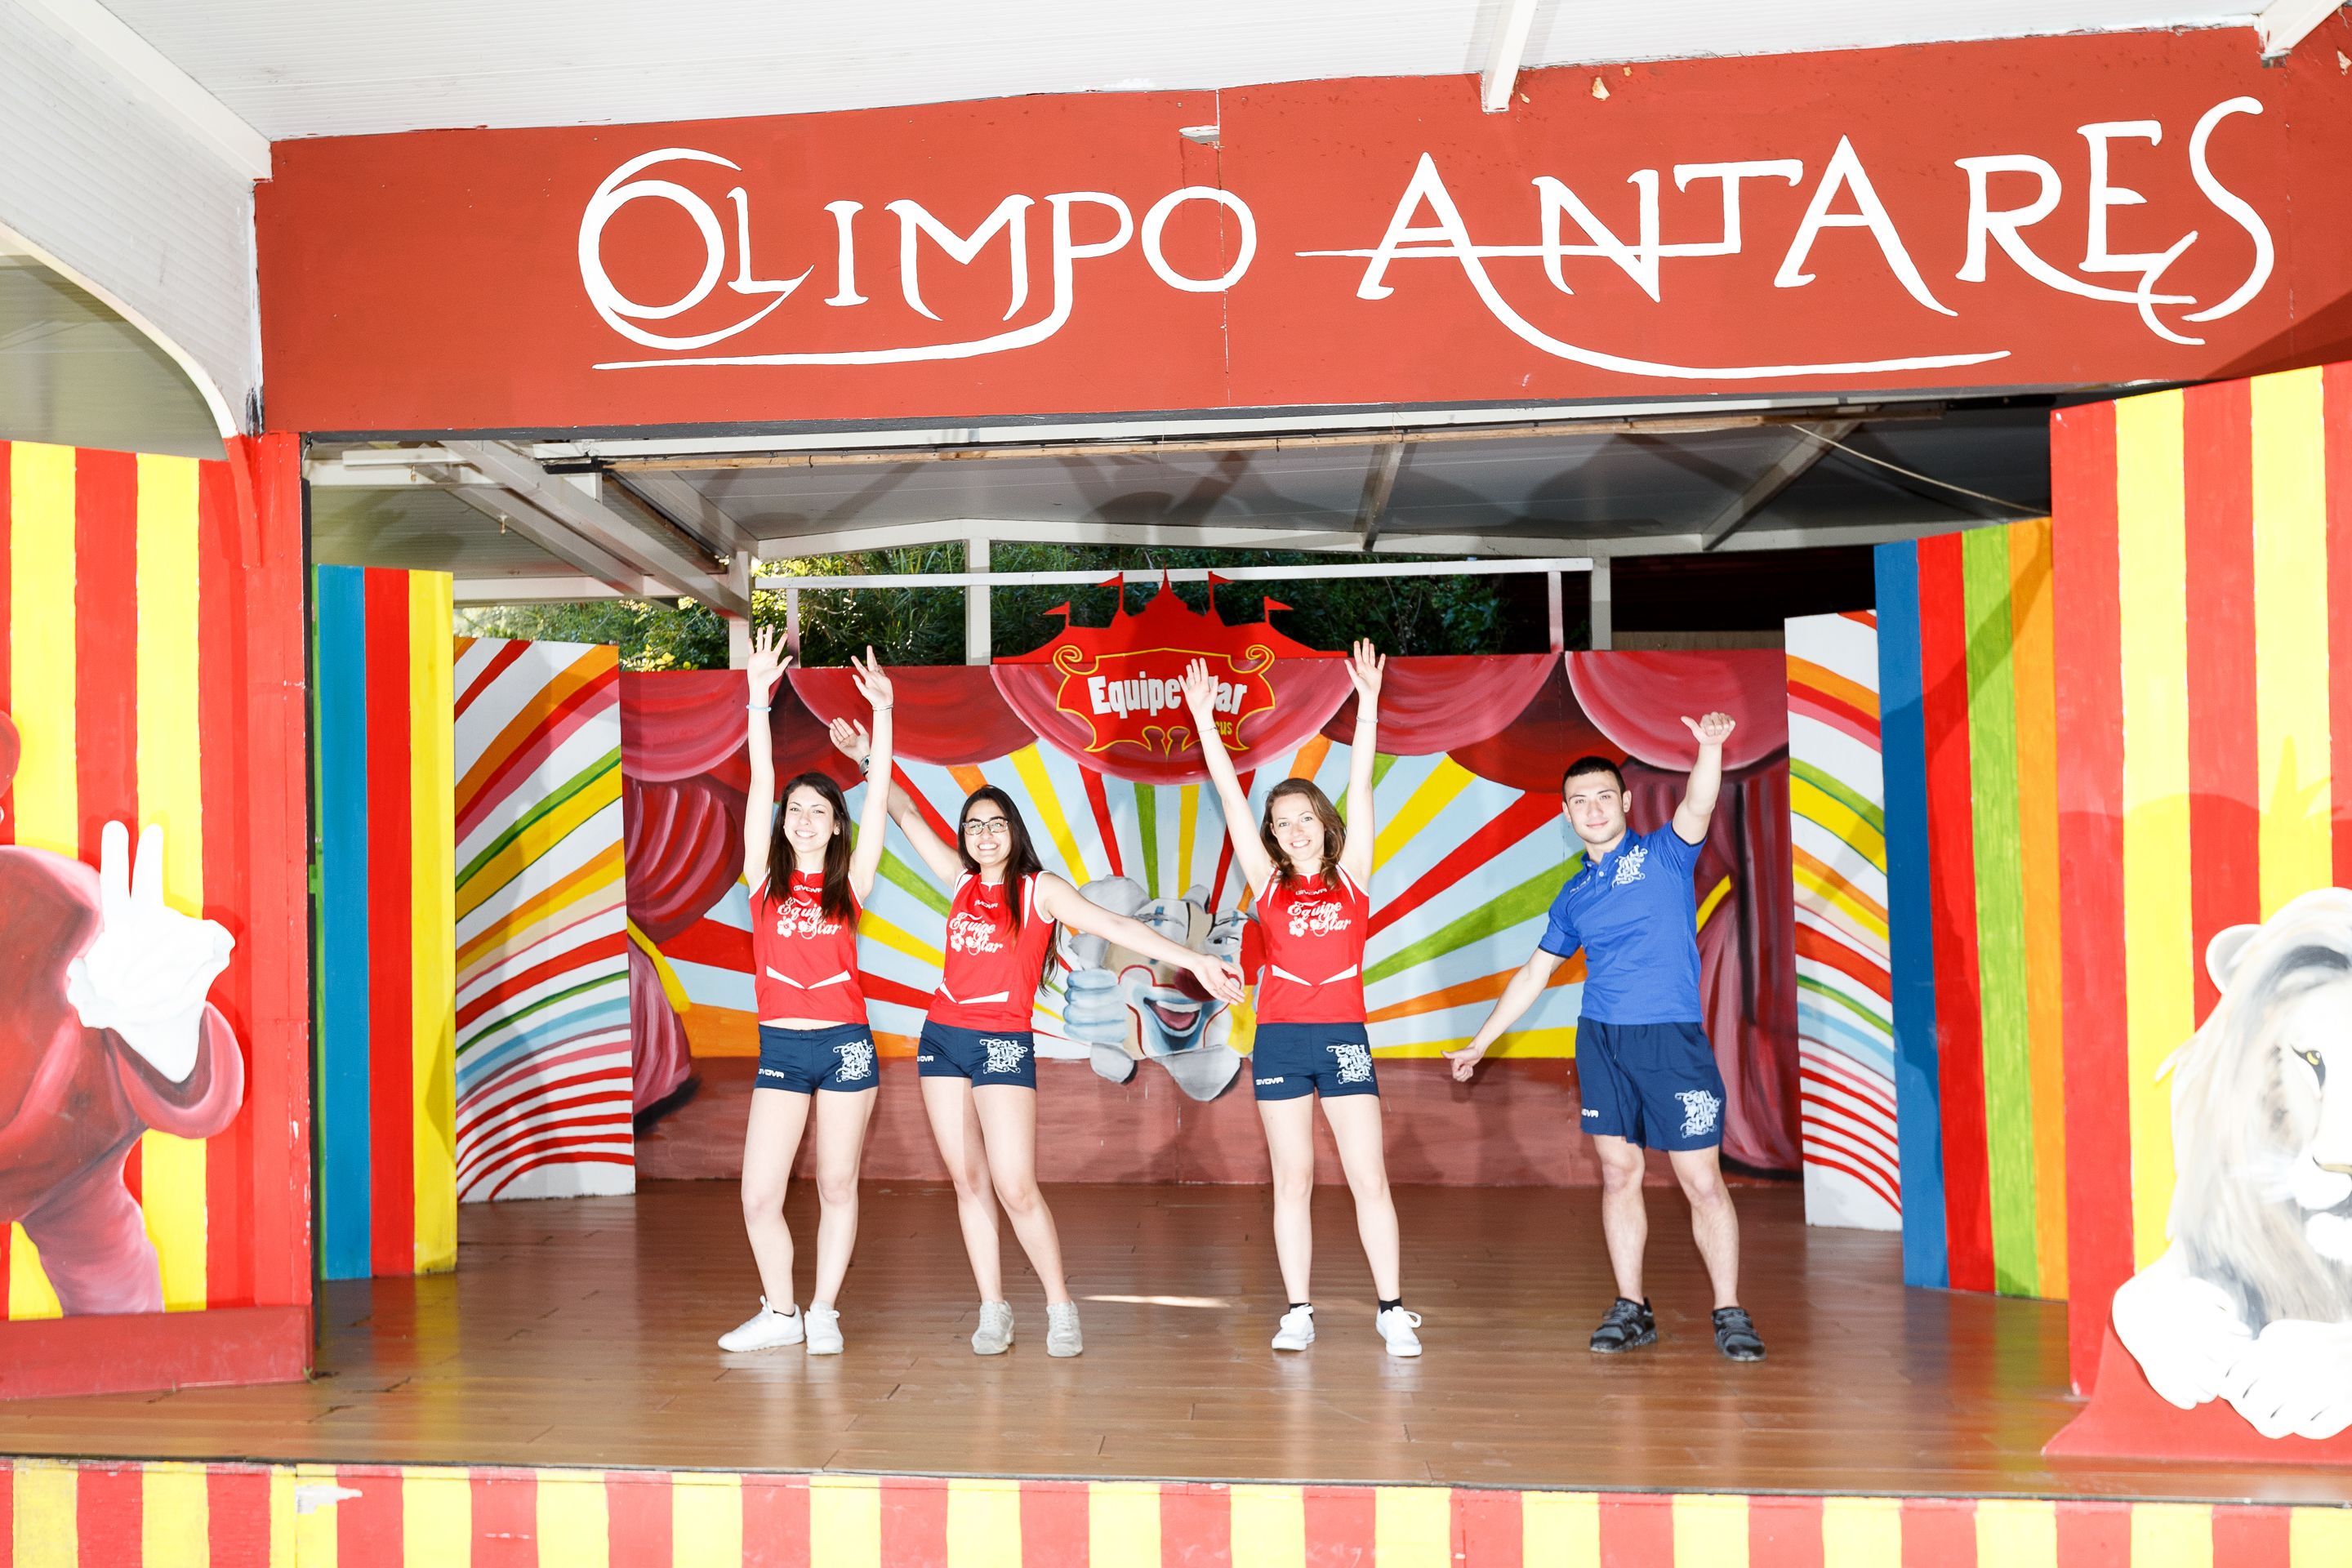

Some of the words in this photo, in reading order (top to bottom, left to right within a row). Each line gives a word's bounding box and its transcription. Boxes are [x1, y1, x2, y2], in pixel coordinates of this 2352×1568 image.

[578, 148, 1257, 369] OLIMPO
[1296, 96, 2274, 379] ANTARES
[1087, 671, 1182, 719] Equipe
[1186, 675, 1248, 715] ar
[777, 897, 823, 921] Equip
[1287, 900, 1342, 920] Equipe
[949, 911, 996, 936] Equipe
[1310, 910, 1352, 937] Star
[965, 930, 1004, 956] Star
